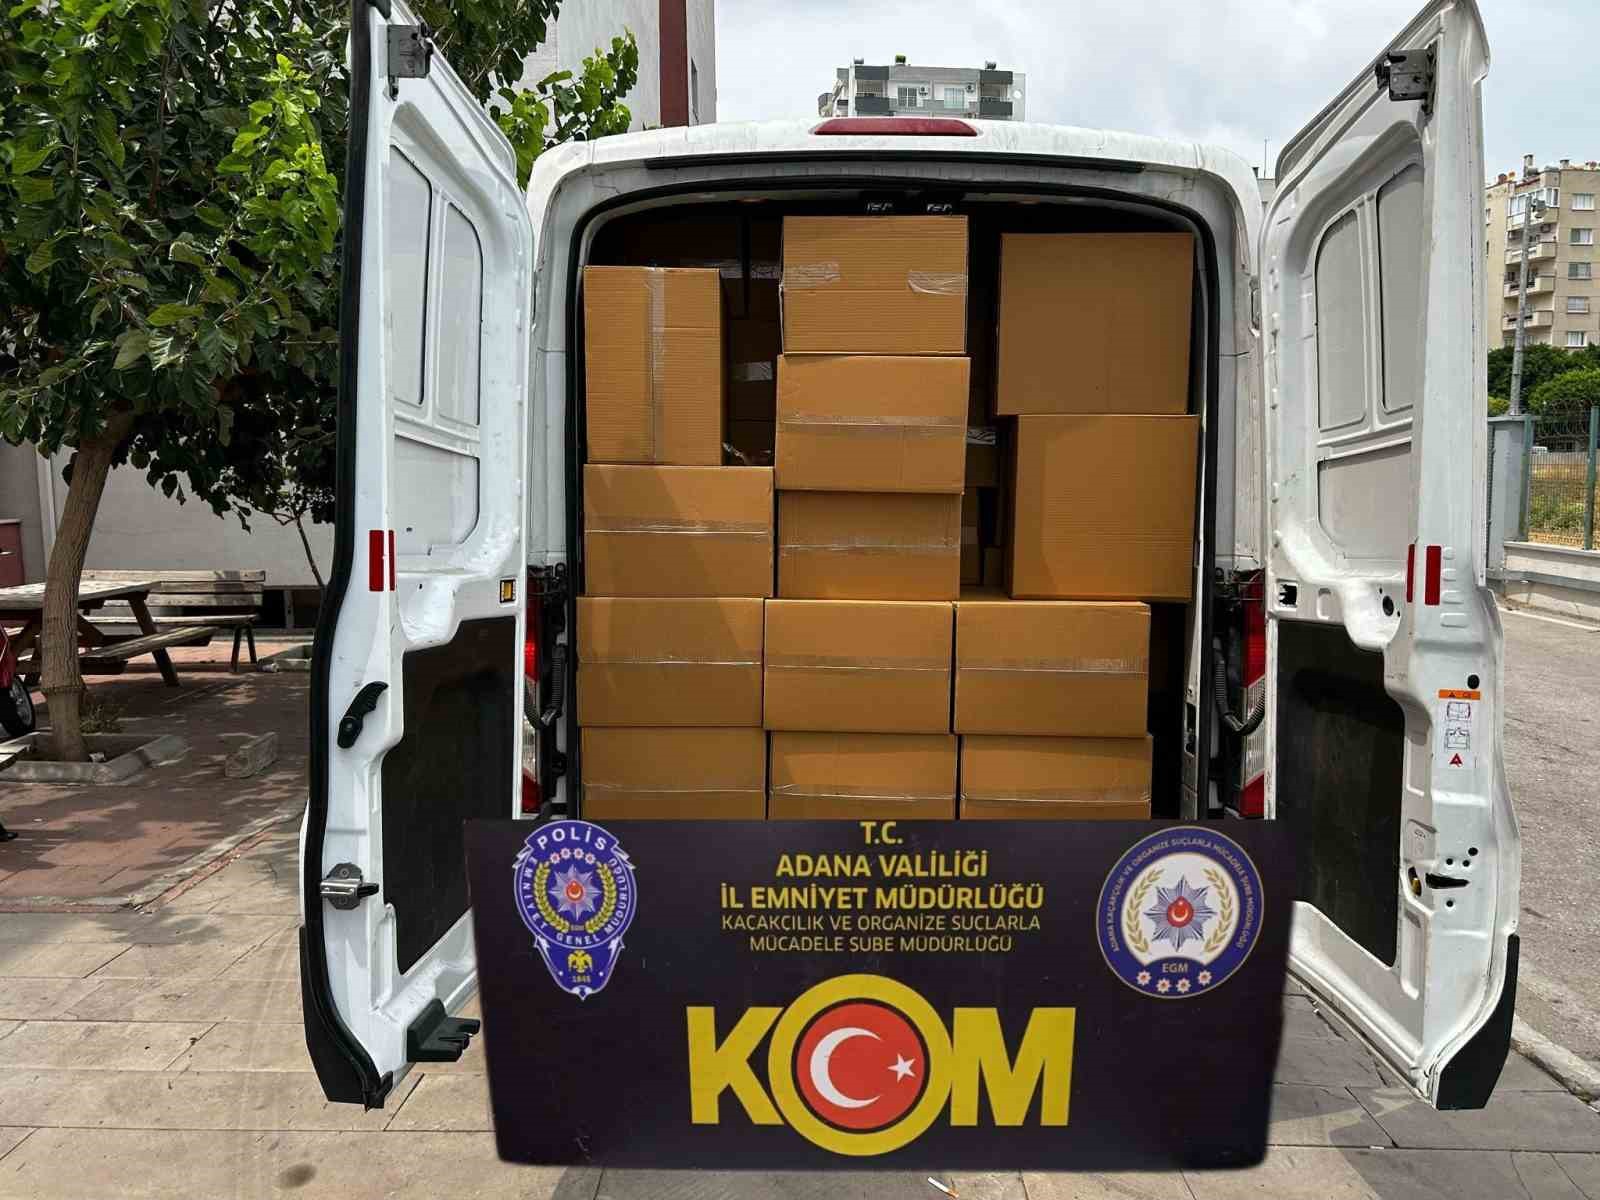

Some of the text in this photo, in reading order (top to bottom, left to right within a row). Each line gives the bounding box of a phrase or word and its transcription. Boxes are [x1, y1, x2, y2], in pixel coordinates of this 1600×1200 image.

[537, 826, 607, 850] POLİS
[860, 821, 903, 844] T.C.
[775, 850, 988, 877] ADANA VALİLİĞİ
[721, 883, 1044, 909] İL EMNİYET MÜDÜRLÜĞÜ
[829, 915, 852, 930] VE
[857, 912, 946, 931] ORGANİZE
[556, 932, 601, 945] GENEL
[1162, 963, 1188, 973] EGM
[686, 973, 1076, 1156] KOM
